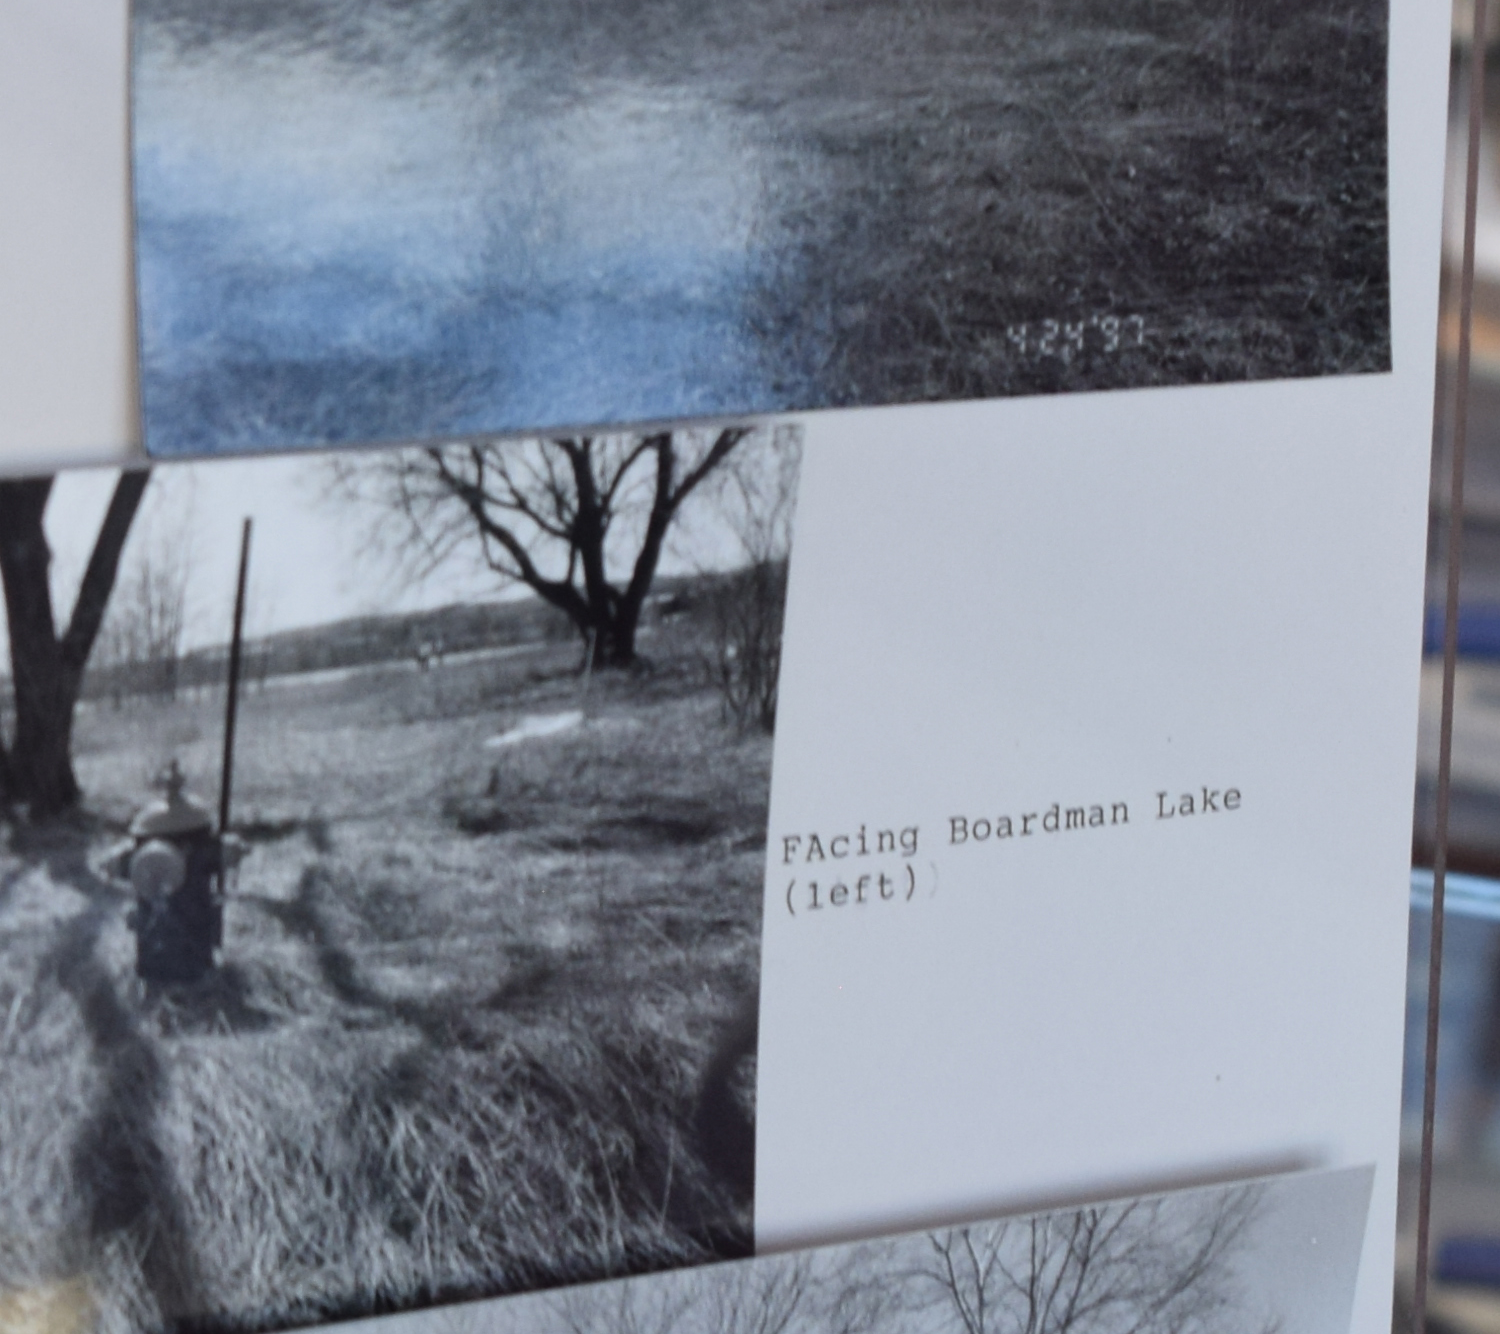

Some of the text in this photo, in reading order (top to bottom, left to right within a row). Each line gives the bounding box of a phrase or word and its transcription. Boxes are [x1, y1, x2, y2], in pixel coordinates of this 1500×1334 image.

[782, 784, 1244, 866] FAcing Boardman Lake
[784, 863, 918, 916] (left)
